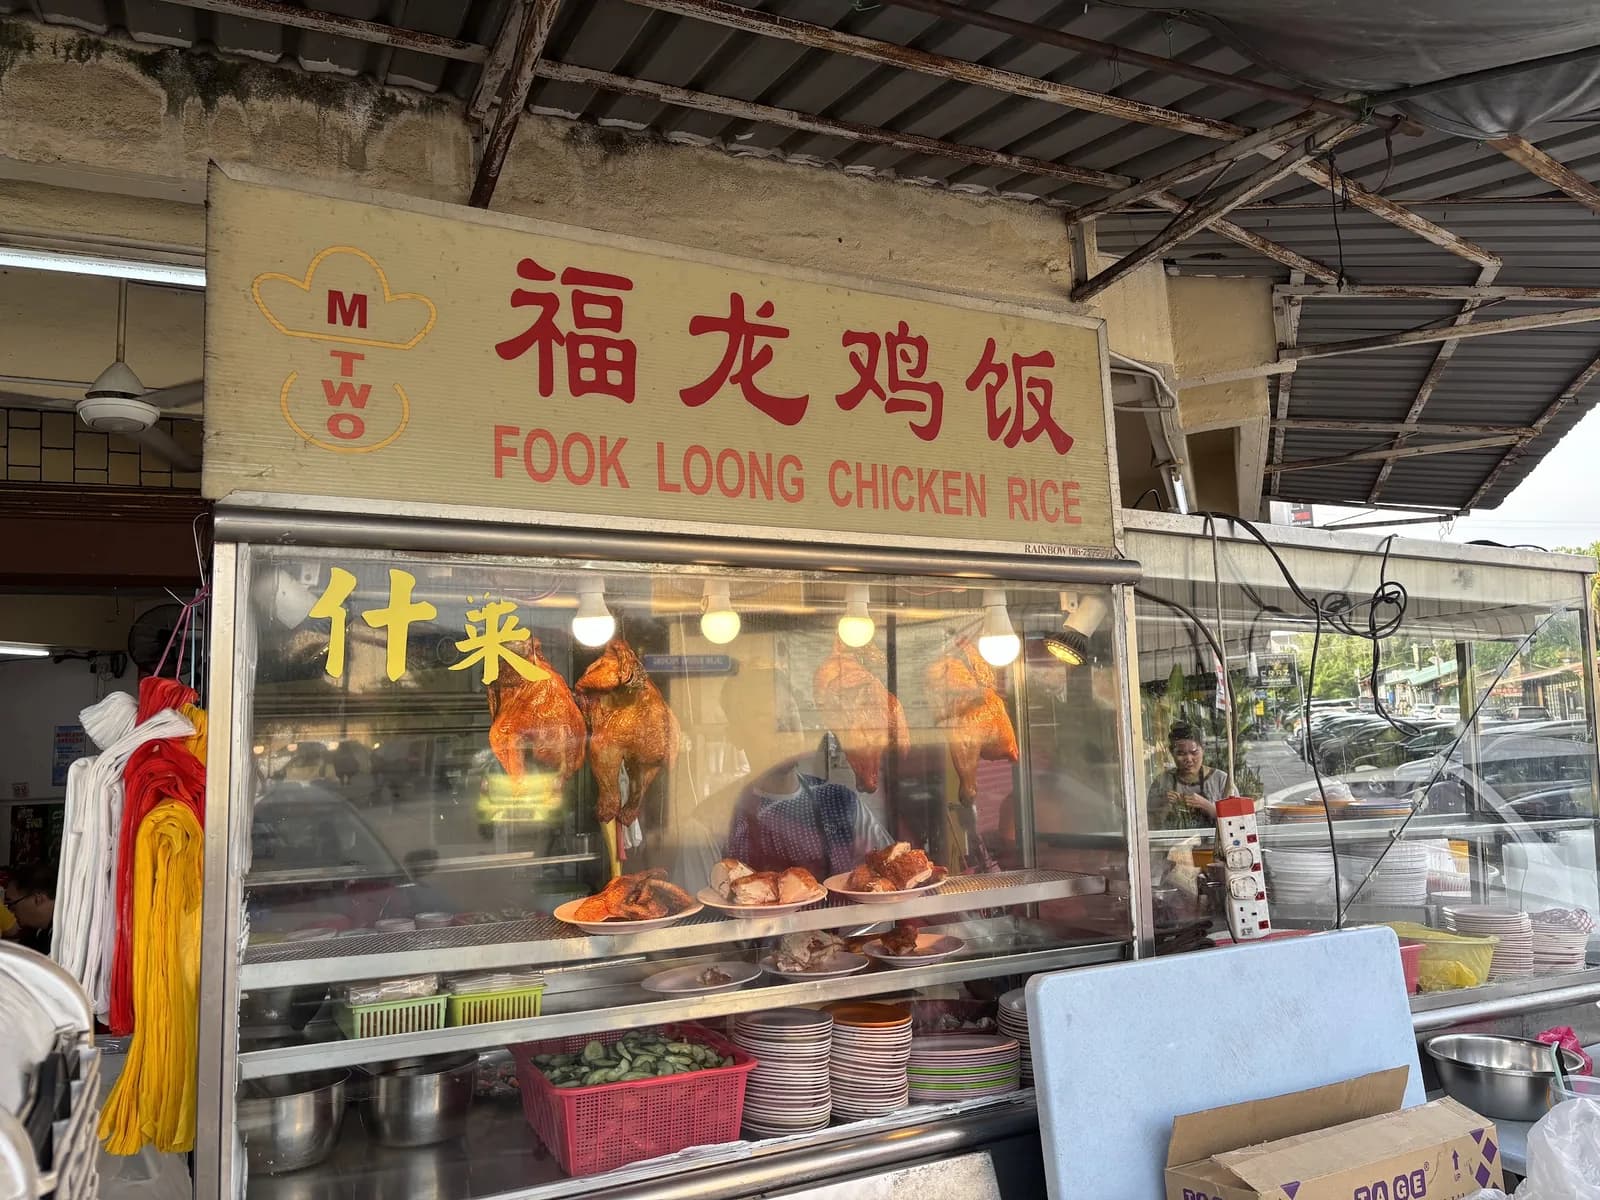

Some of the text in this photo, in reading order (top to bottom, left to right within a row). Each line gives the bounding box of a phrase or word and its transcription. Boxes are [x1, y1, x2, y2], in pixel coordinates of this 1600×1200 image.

[327, 290, 368, 329] M
[495, 257, 1074, 455] 福龙鸡饭
[493, 425, 1082, 524] FOOK LOONG CHICKEN RICE
[1024, 543, 1065, 555] RAINBOW
